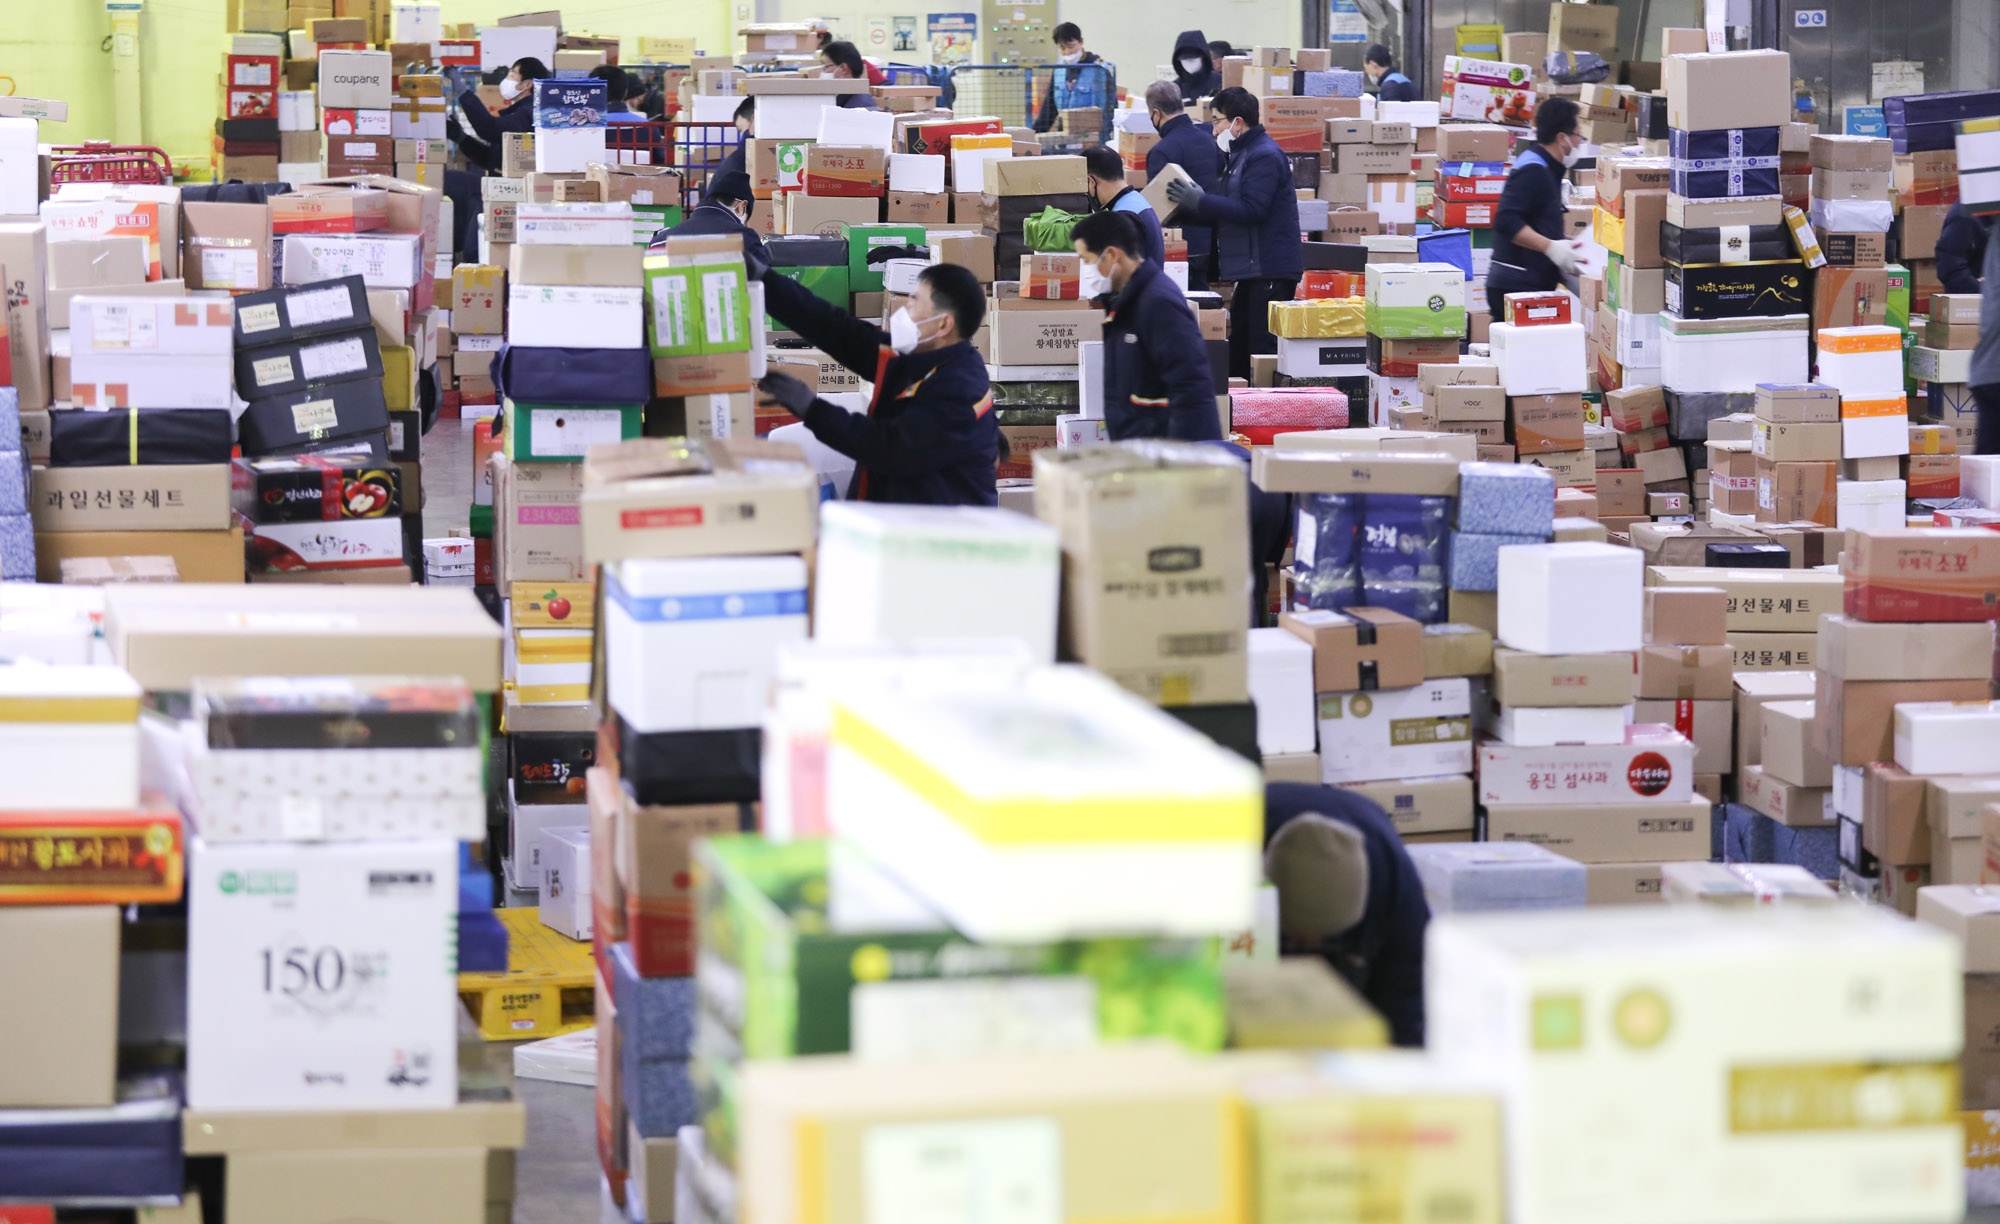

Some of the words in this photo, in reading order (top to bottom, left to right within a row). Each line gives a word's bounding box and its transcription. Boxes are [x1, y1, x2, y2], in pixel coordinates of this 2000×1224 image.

[334, 74, 380, 86] coupang
[822, 159, 843, 168] 우체국
[845, 159, 865, 170] 소포
[1453, 186, 1474, 194] 사과
[77, 216, 98, 229] 쇼핑
[323, 247, 354, 256] 장수사과
[1042, 328, 1074, 337] 숙성발효
[819, 363, 845, 373] 급주의
[1013, 441, 1039, 450] 우체국
[47, 488, 185, 510] 과일선물세트
[1898, 557, 1933, 571] 우체국
[1934, 555, 1969, 573] 소포
[1727, 598, 1811, 613] 일선물세트
[1526, 773, 1557, 790] 옹진
[1563, 772, 1608, 788] 섬사과
[259, 946, 346, 994] 150
